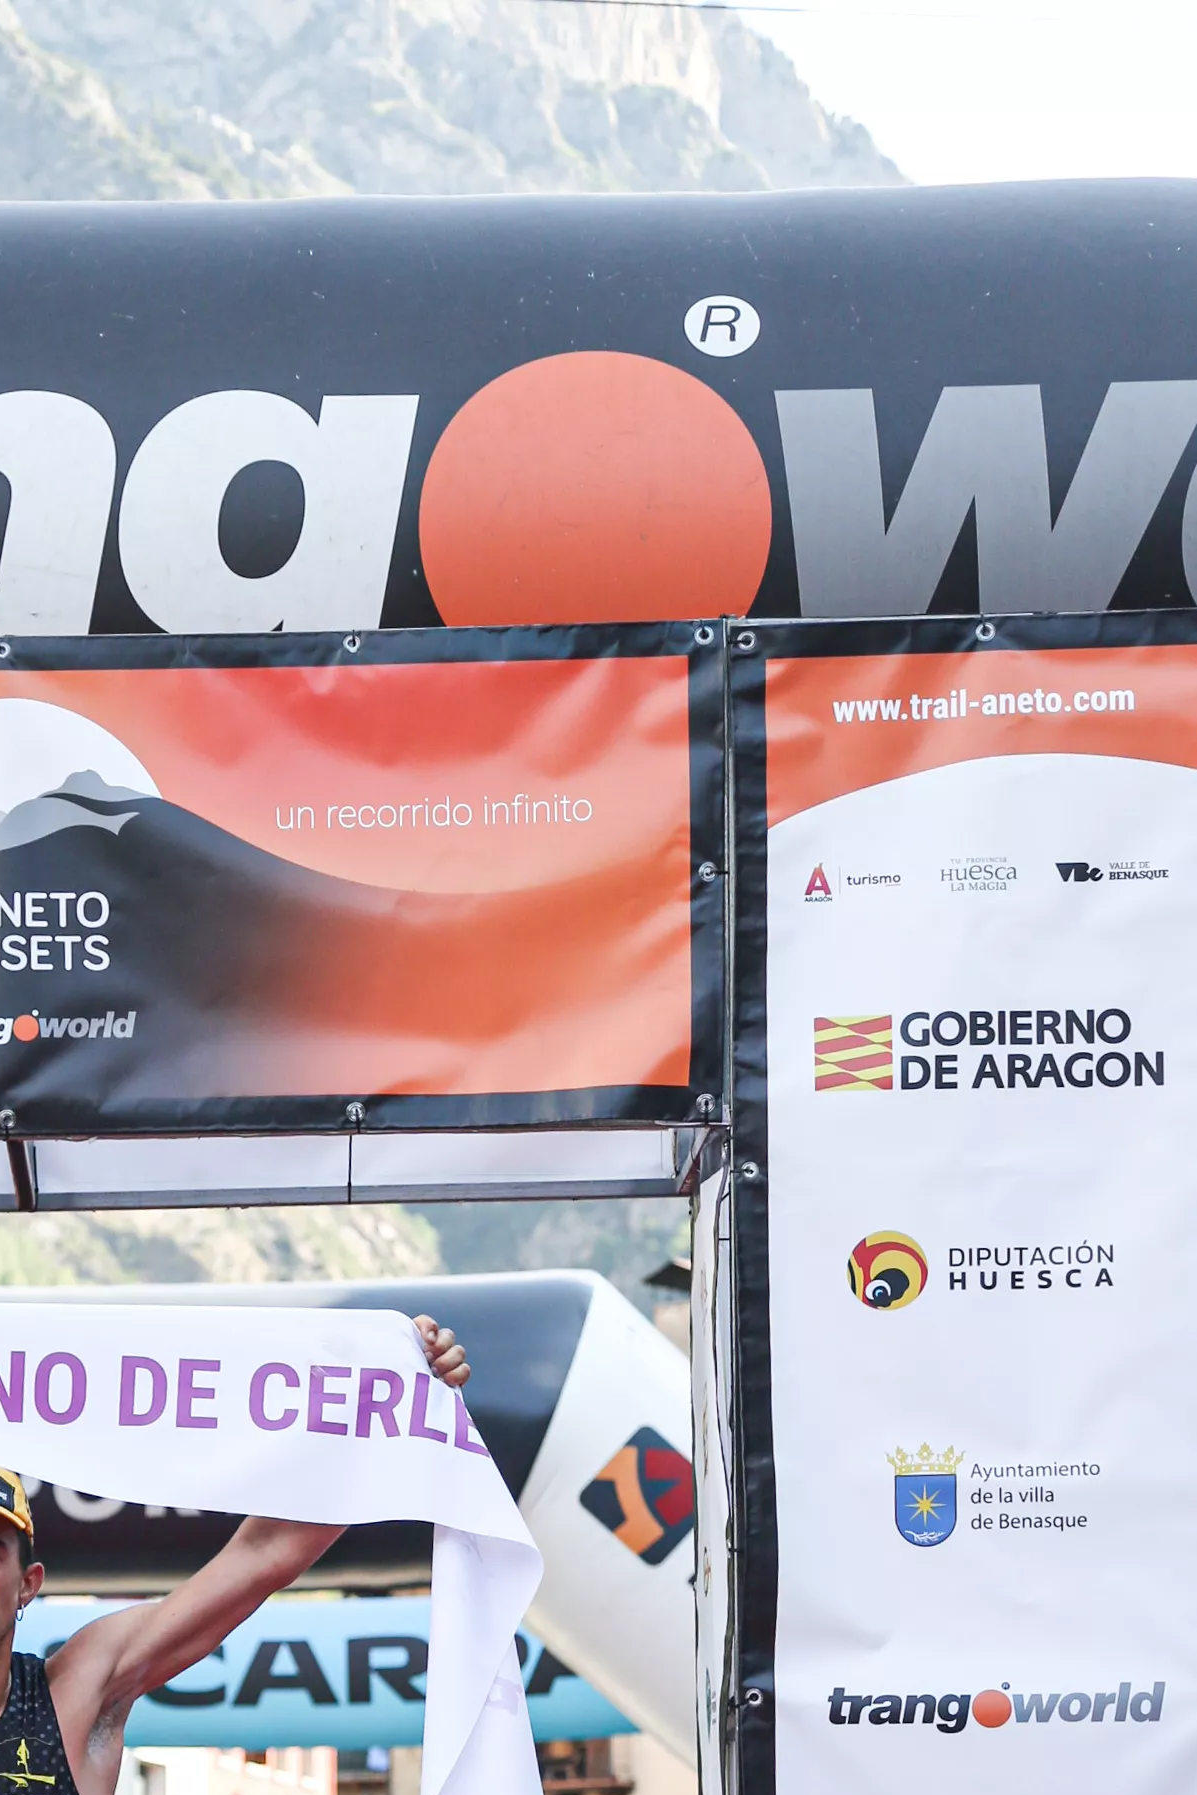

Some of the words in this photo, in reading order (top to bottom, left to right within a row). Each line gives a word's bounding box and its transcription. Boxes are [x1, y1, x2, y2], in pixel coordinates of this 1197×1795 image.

[833, 689, 1135, 723] www.trail-aneto.com
[275, 806, 316, 830] un
[326, 796, 472, 829] recorrido
[483, 793, 593, 825] infinito
[1109, 862, 1135, 870] VALLE
[1139, 861, 1150, 869] DE
[1109, 869, 1169, 881] BENASQUE
[847, 873, 901, 886] turismo
[900, 1008, 1132, 1047] GOBIERNO
[901, 1055, 958, 1090] DE
[972, 1051, 1165, 1089] ARAGON
[949, 1240, 1114, 1267] DIPUTACIÓN
[950, 1268, 1114, 1290] HUESCA
[119, 1355, 221, 1430] DE
[970, 1461, 1101, 1482] Ayuntamiento
[970, 1487, 993, 1504] de
[998, 1487, 1013, 1504] la
[1019, 1486, 1054, 1503] villa
[970, 1513, 993, 1530] de
[999, 1511, 1088, 1532] Benasque
